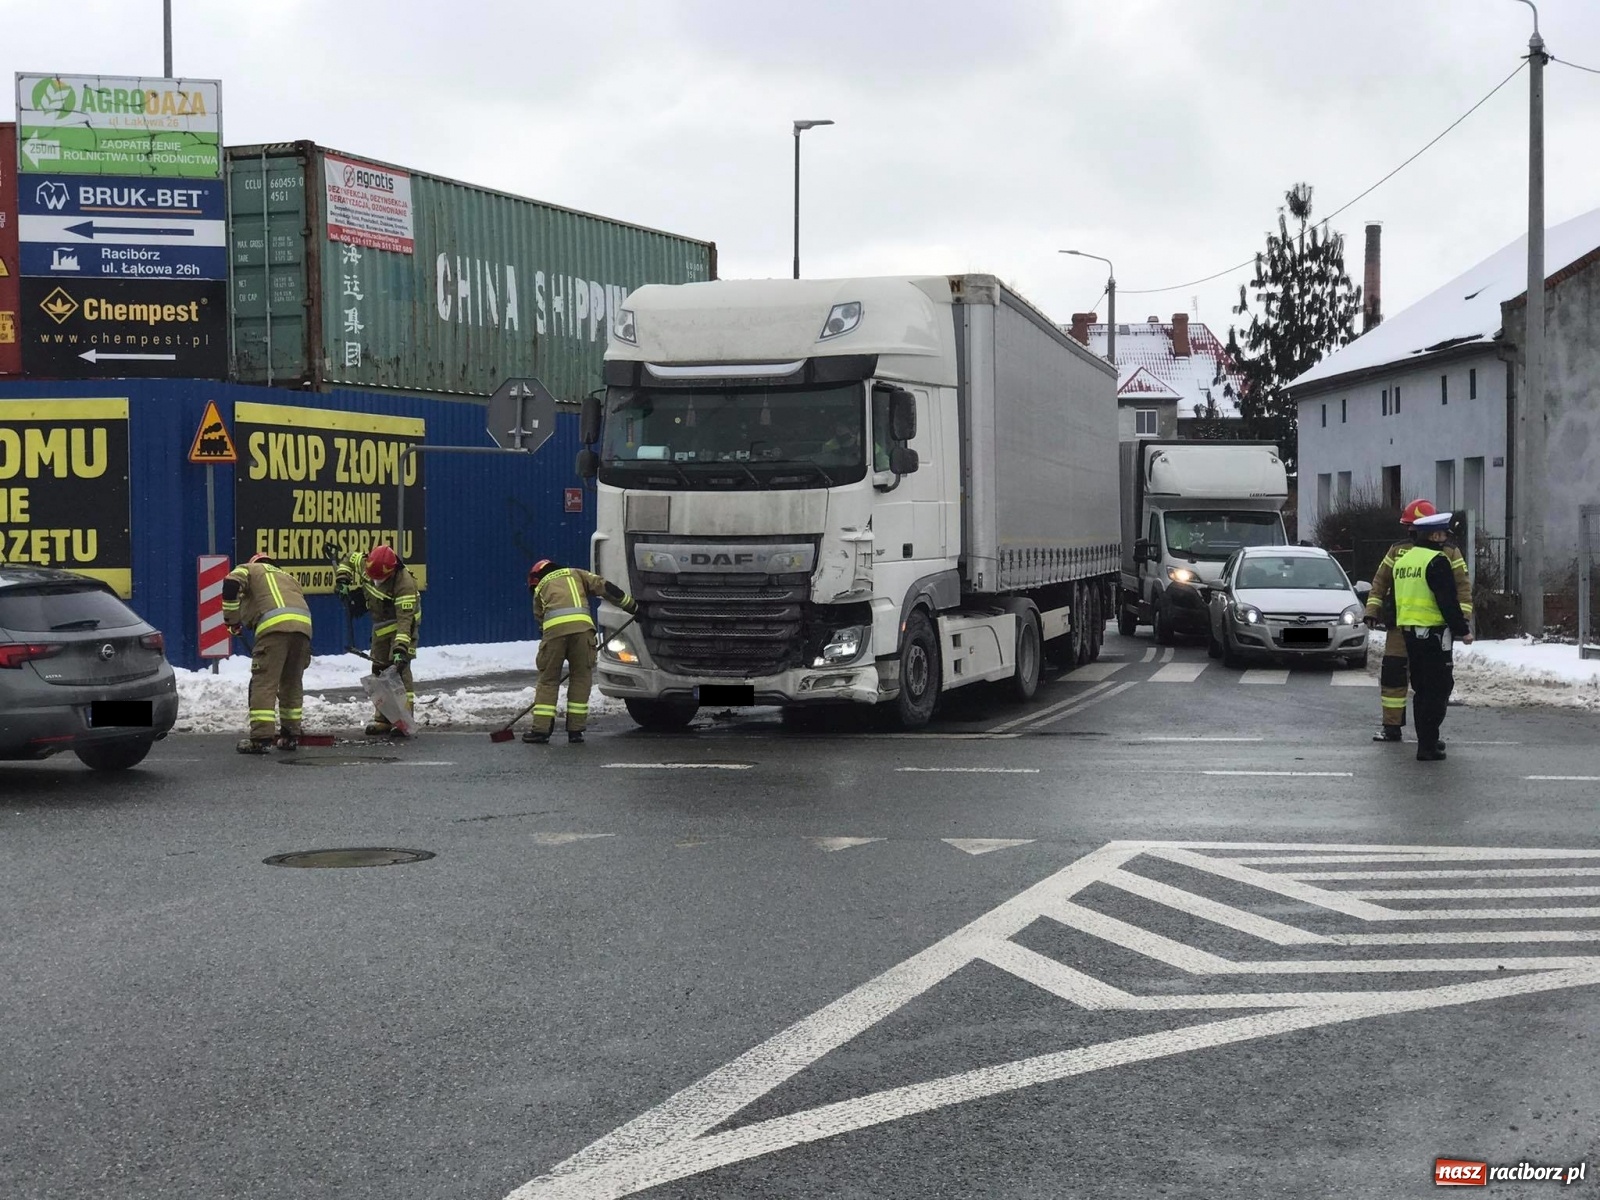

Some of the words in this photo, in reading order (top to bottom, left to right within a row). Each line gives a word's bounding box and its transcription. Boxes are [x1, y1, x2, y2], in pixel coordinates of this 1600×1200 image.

[167, 118, 179, 127] 26
[101, 140, 182, 151] ZAOPATRZENIE
[63, 151, 129, 162] ROLNICTWA
[245, 179, 262, 189] CCLU
[270, 177, 296, 188] 660455
[357, 170, 394, 190] Agrotis
[101, 248, 160, 260] Racibórz
[101, 263, 118, 273] ul.
[121, 262, 172, 276] Łąkowa
[176, 263, 200, 275] 26h
[436, 252, 519, 331] CHINA
[40, 333, 209, 347] www.chempest.pl
[249, 431, 326, 482] SKUP
[334, 437, 417, 487] ZŁOMU
[292, 489, 381, 524] ZBIERANIE
[691, 553, 753, 566] DAF
[312, 571, 322, 587] 60
[324, 571, 333, 587] 60
